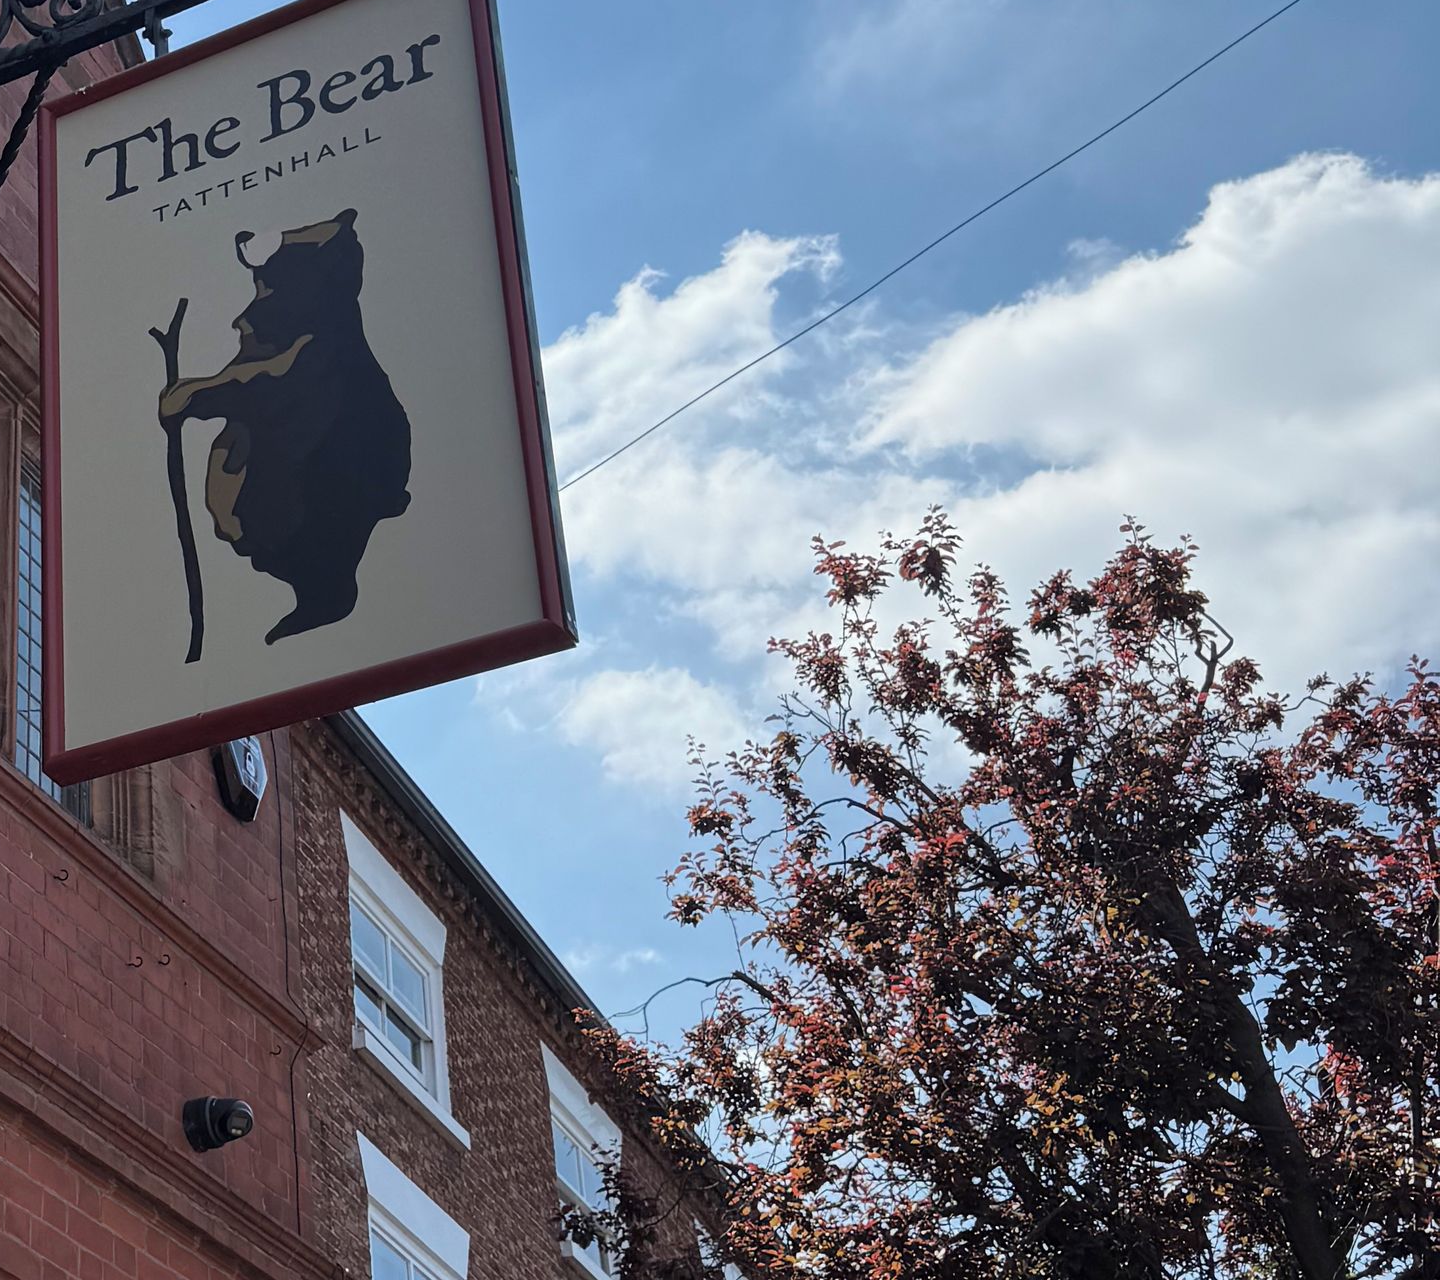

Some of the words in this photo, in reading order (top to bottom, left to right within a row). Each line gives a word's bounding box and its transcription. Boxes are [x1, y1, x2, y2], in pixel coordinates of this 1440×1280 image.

[85, 116, 241, 201] The
[257, 34, 440, 143] Bear
[153, 128, 381, 222] TATTENHALL
